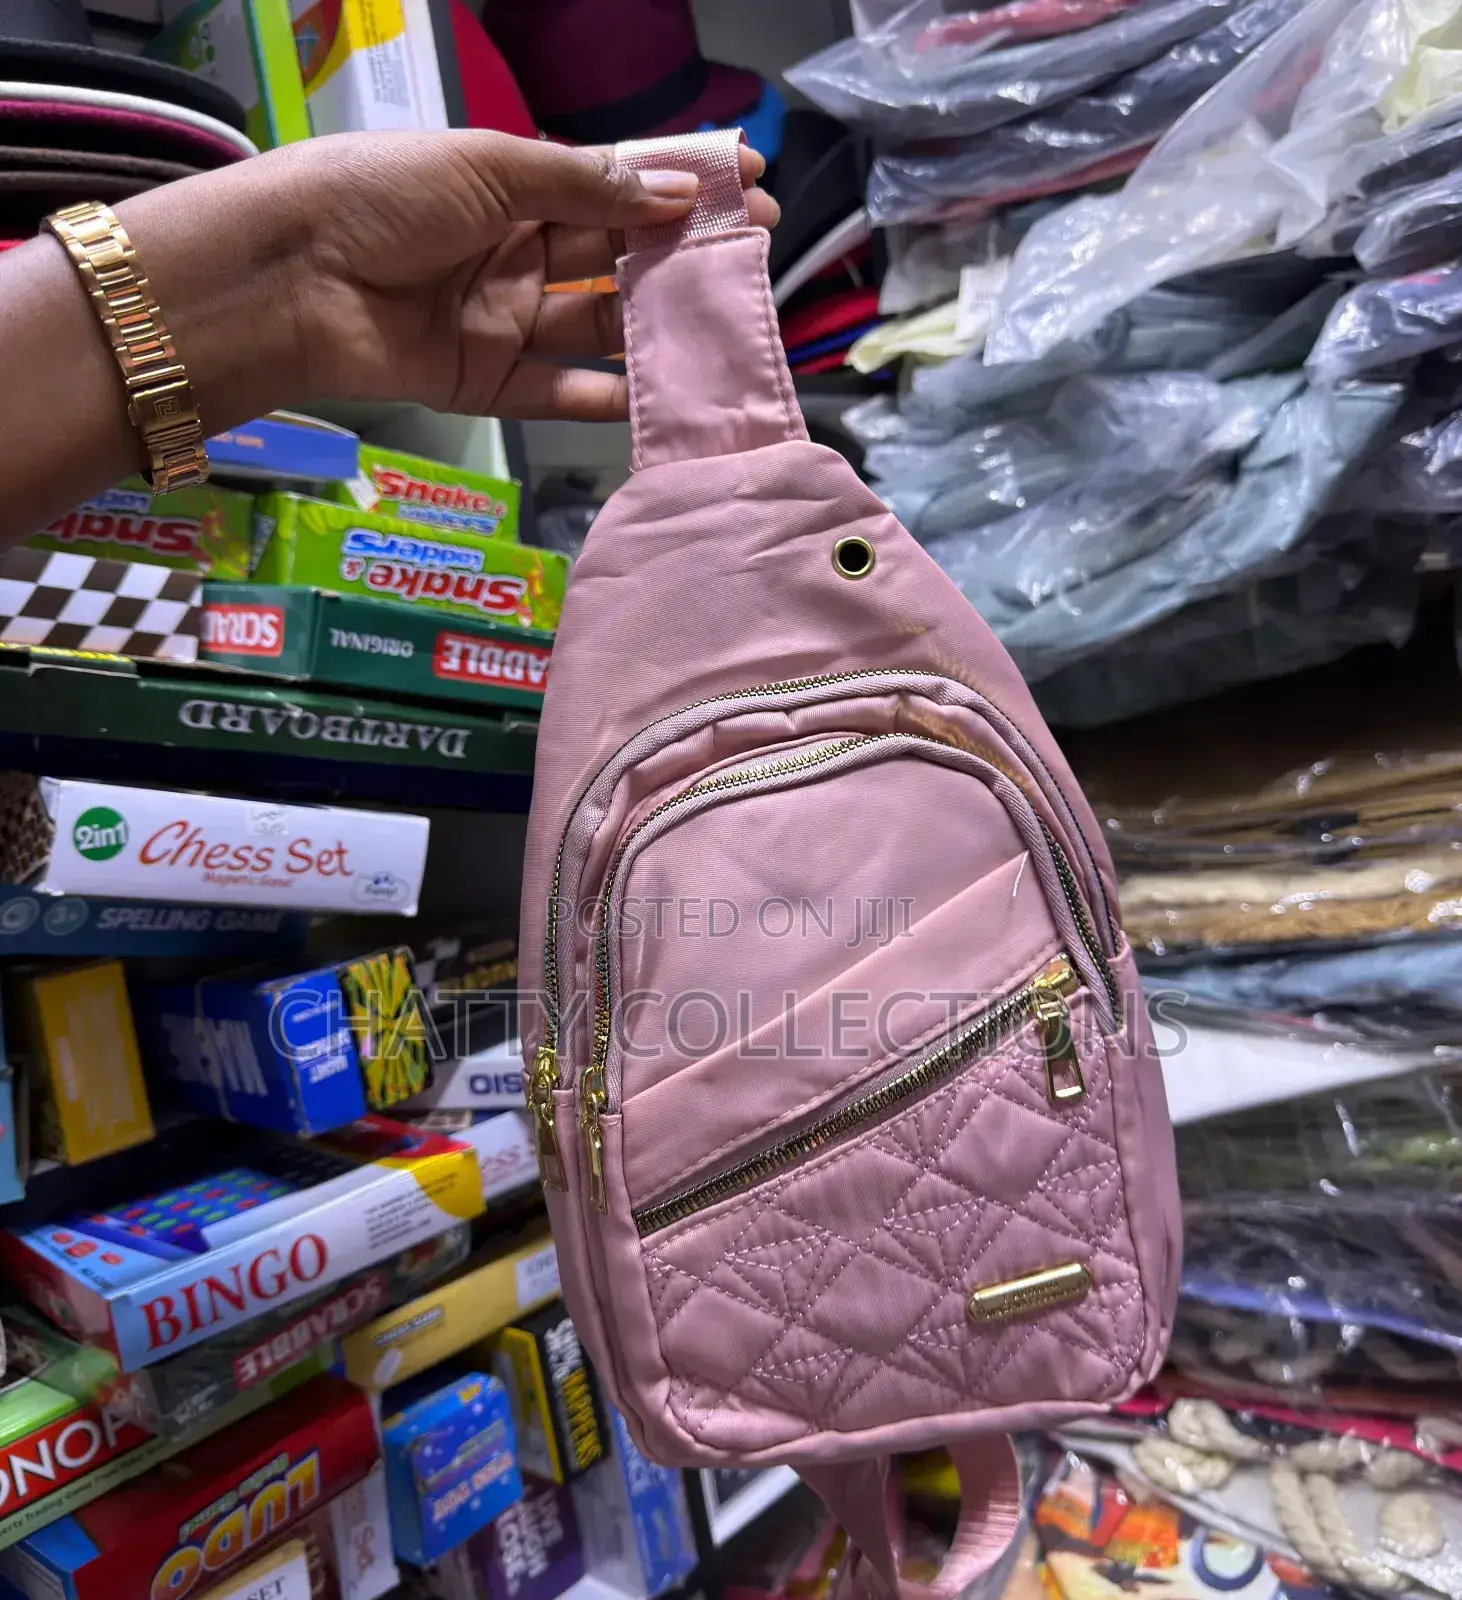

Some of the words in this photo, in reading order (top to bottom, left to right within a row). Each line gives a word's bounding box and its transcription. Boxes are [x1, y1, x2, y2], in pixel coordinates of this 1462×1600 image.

[373, 468, 491, 512] Snake
[344, 529, 485, 570] Ladders
[366, 560, 527, 615] Snake
[330, 627, 414, 659] ORIGINAL
[179, 699, 471, 760] DARTBOARD
[74, 820, 128, 851] 2in1
[137, 820, 273, 872] Chess
[285, 837, 354, 877] Set
[96, 907, 211, 931] SPELLING
[140, 1233, 329, 1352] BINGO
[151, 1453, 320, 1600] LUDO
